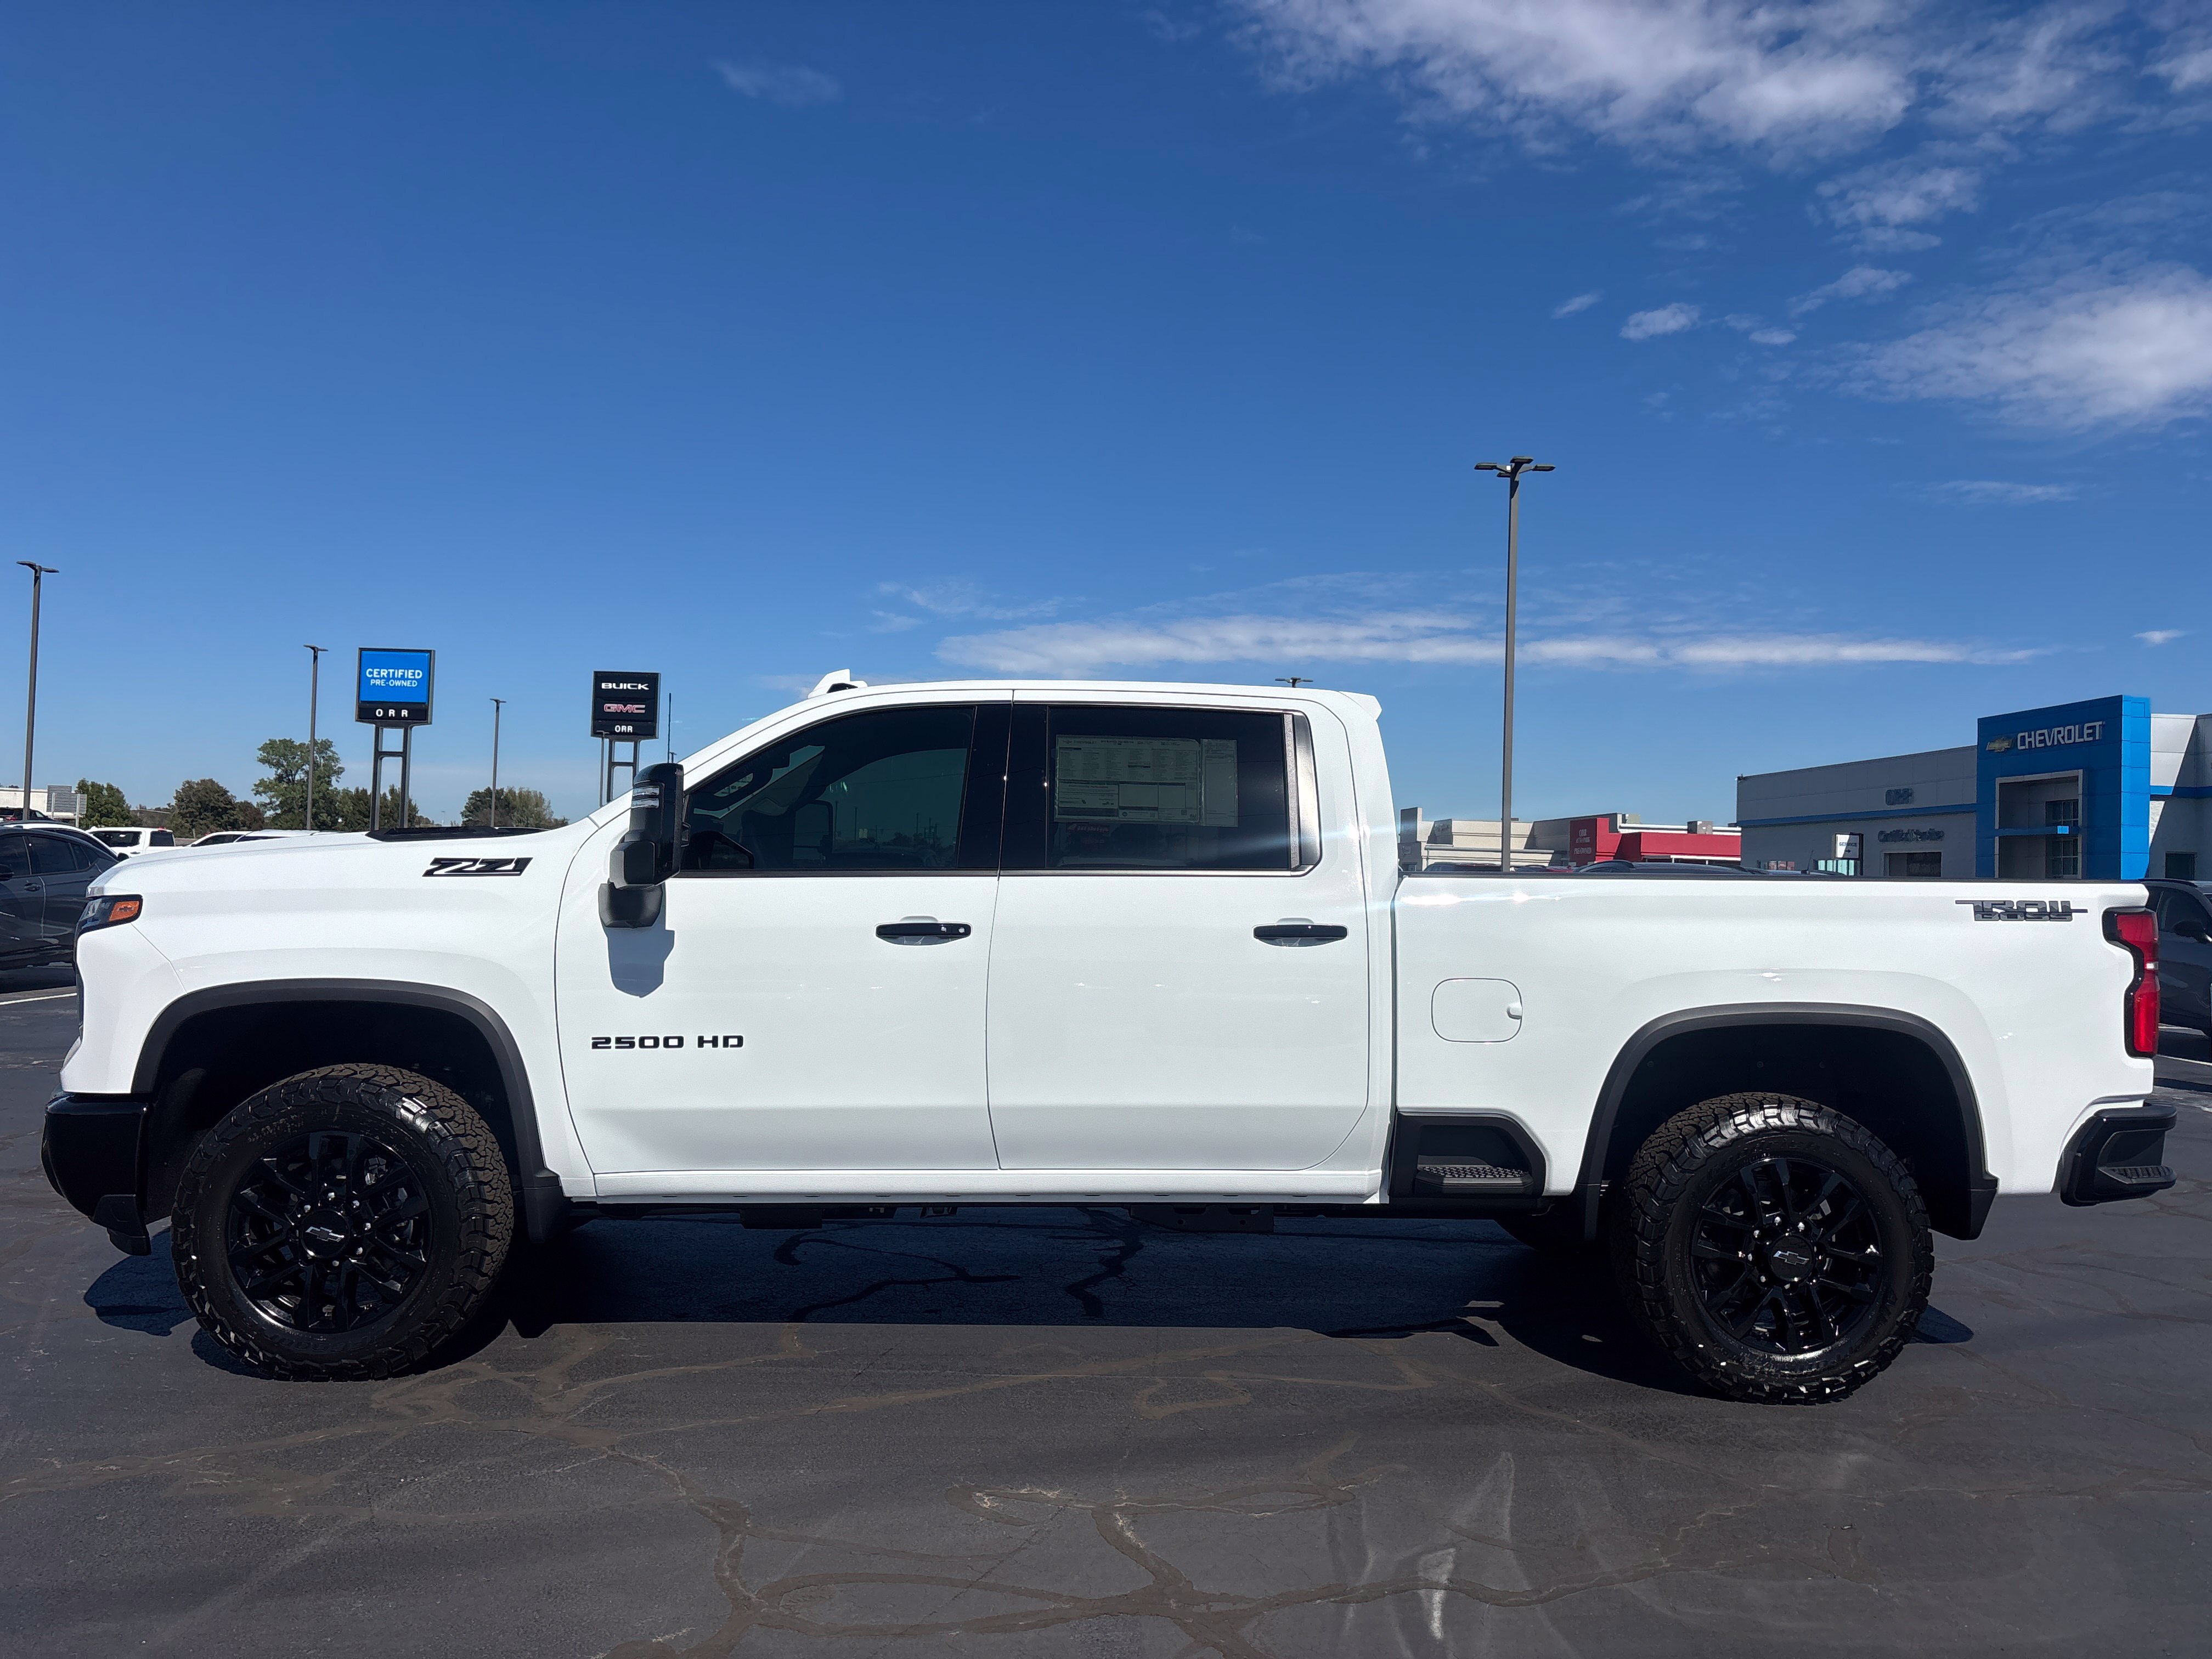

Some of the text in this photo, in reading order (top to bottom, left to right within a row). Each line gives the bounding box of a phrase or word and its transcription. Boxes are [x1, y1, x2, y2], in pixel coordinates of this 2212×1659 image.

[366, 668, 422, 679] CERTIFIED
[603, 703, 646, 713] GMC
[614, 725, 633, 733] ORR
[2017, 721, 2103, 750] CHEVROLET
[422, 857, 533, 877] Z71
[591, 1035, 744, 1049] 2500 HD
